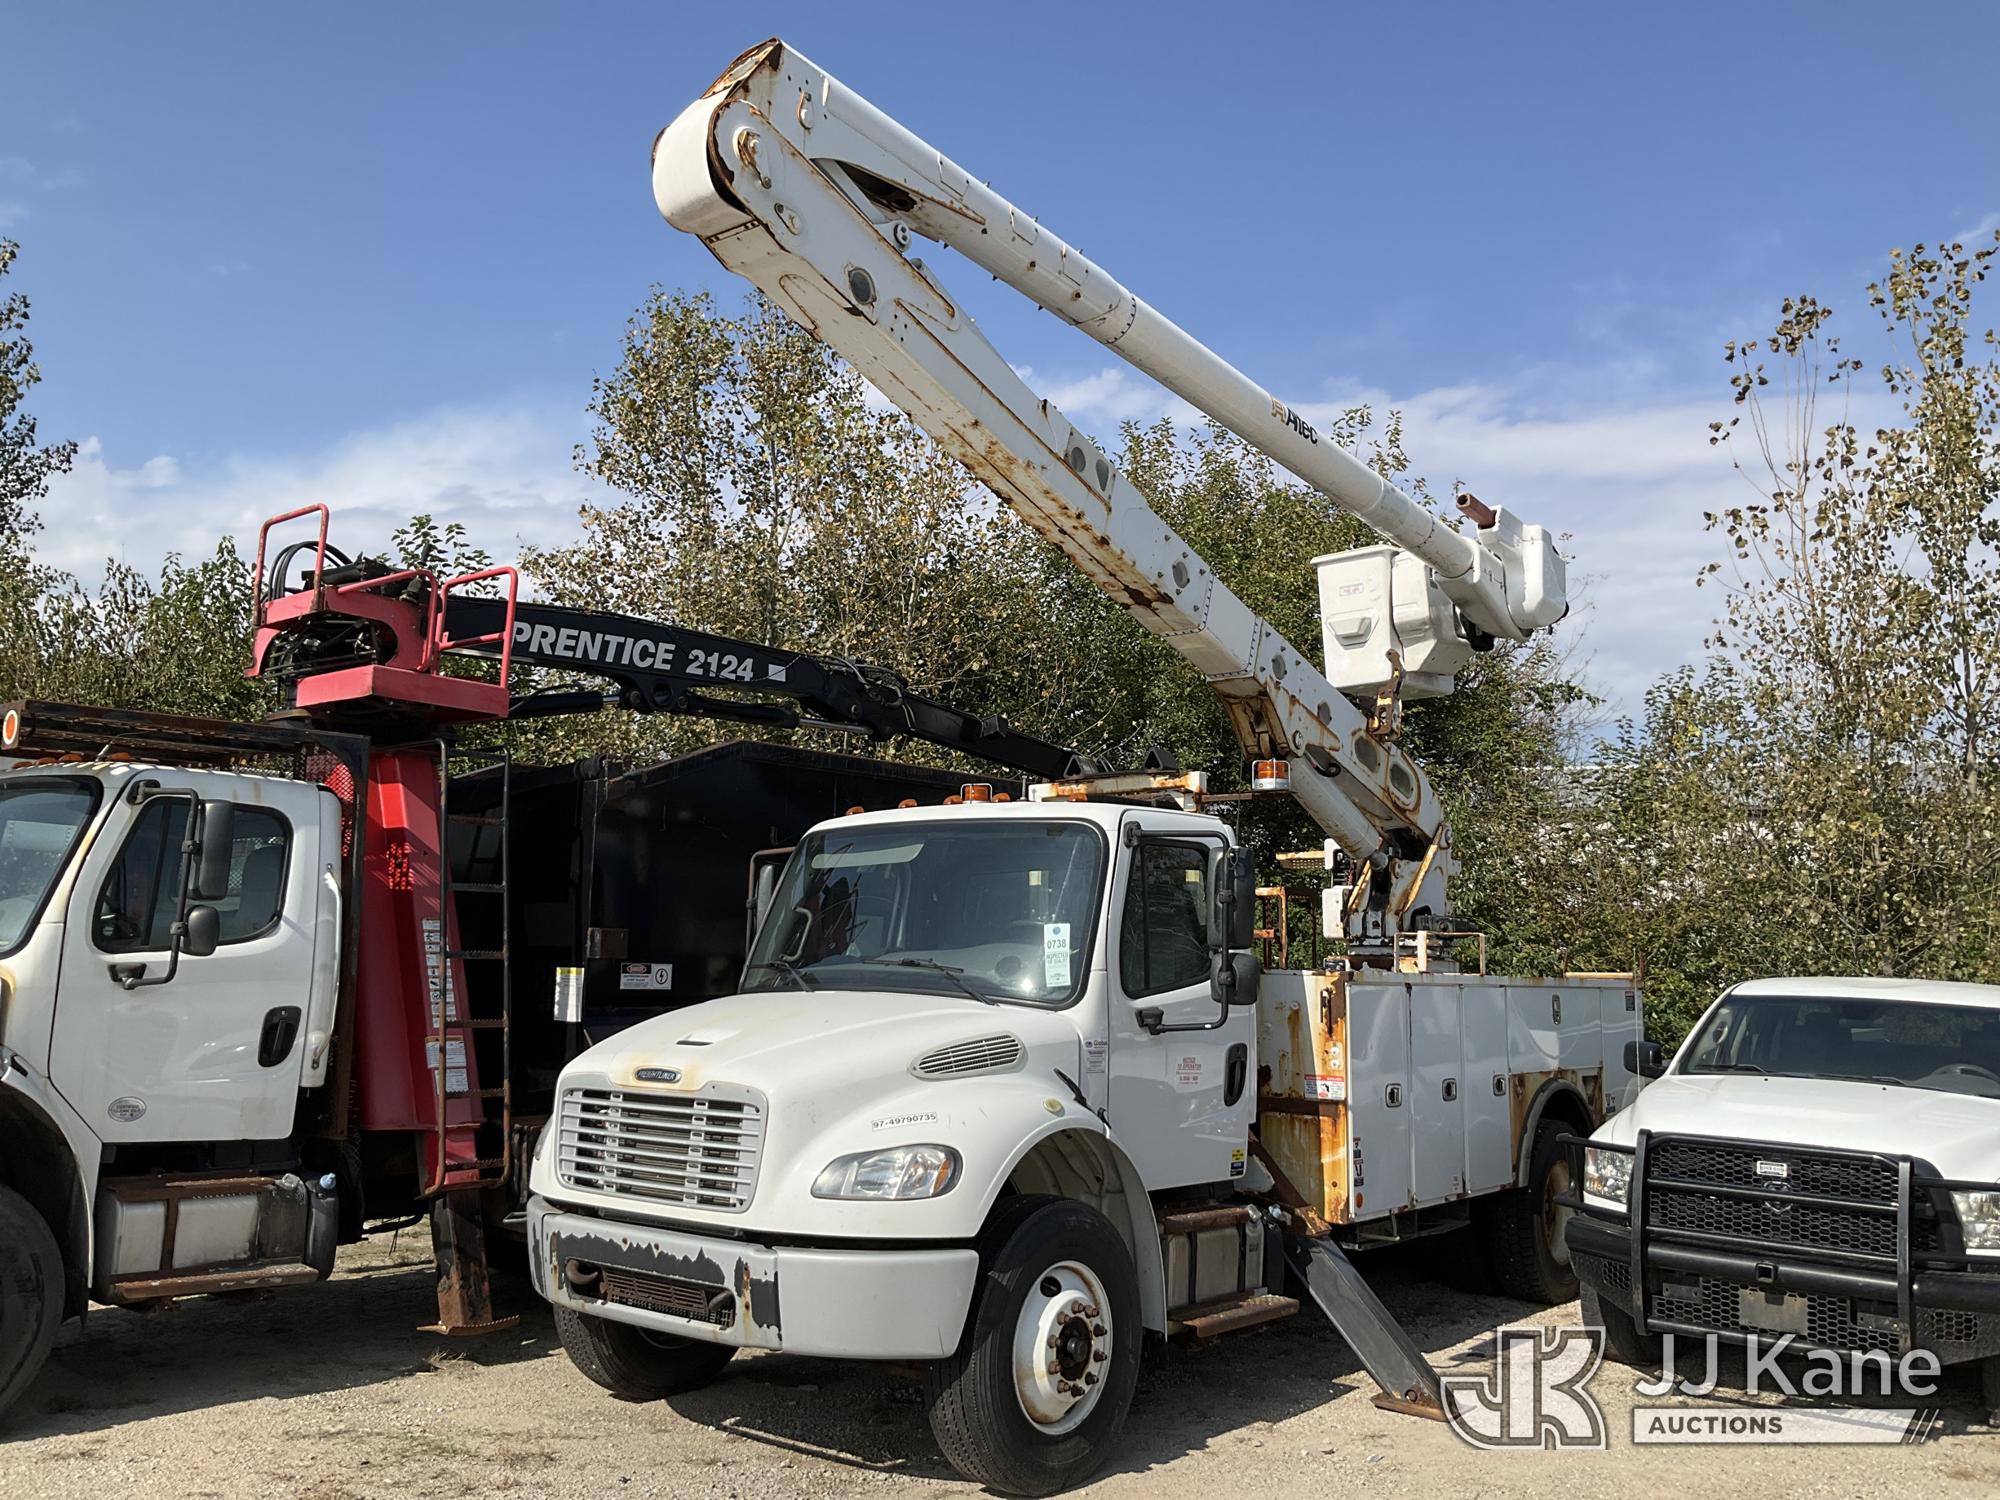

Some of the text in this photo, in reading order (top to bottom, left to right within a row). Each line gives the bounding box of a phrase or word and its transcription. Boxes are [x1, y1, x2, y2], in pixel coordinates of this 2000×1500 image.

[512, 621, 754, 682] PRENTICE 2124
[1047, 939, 1066, 949] 0738
[873, 1113, 936, 1128] 97-49790735
